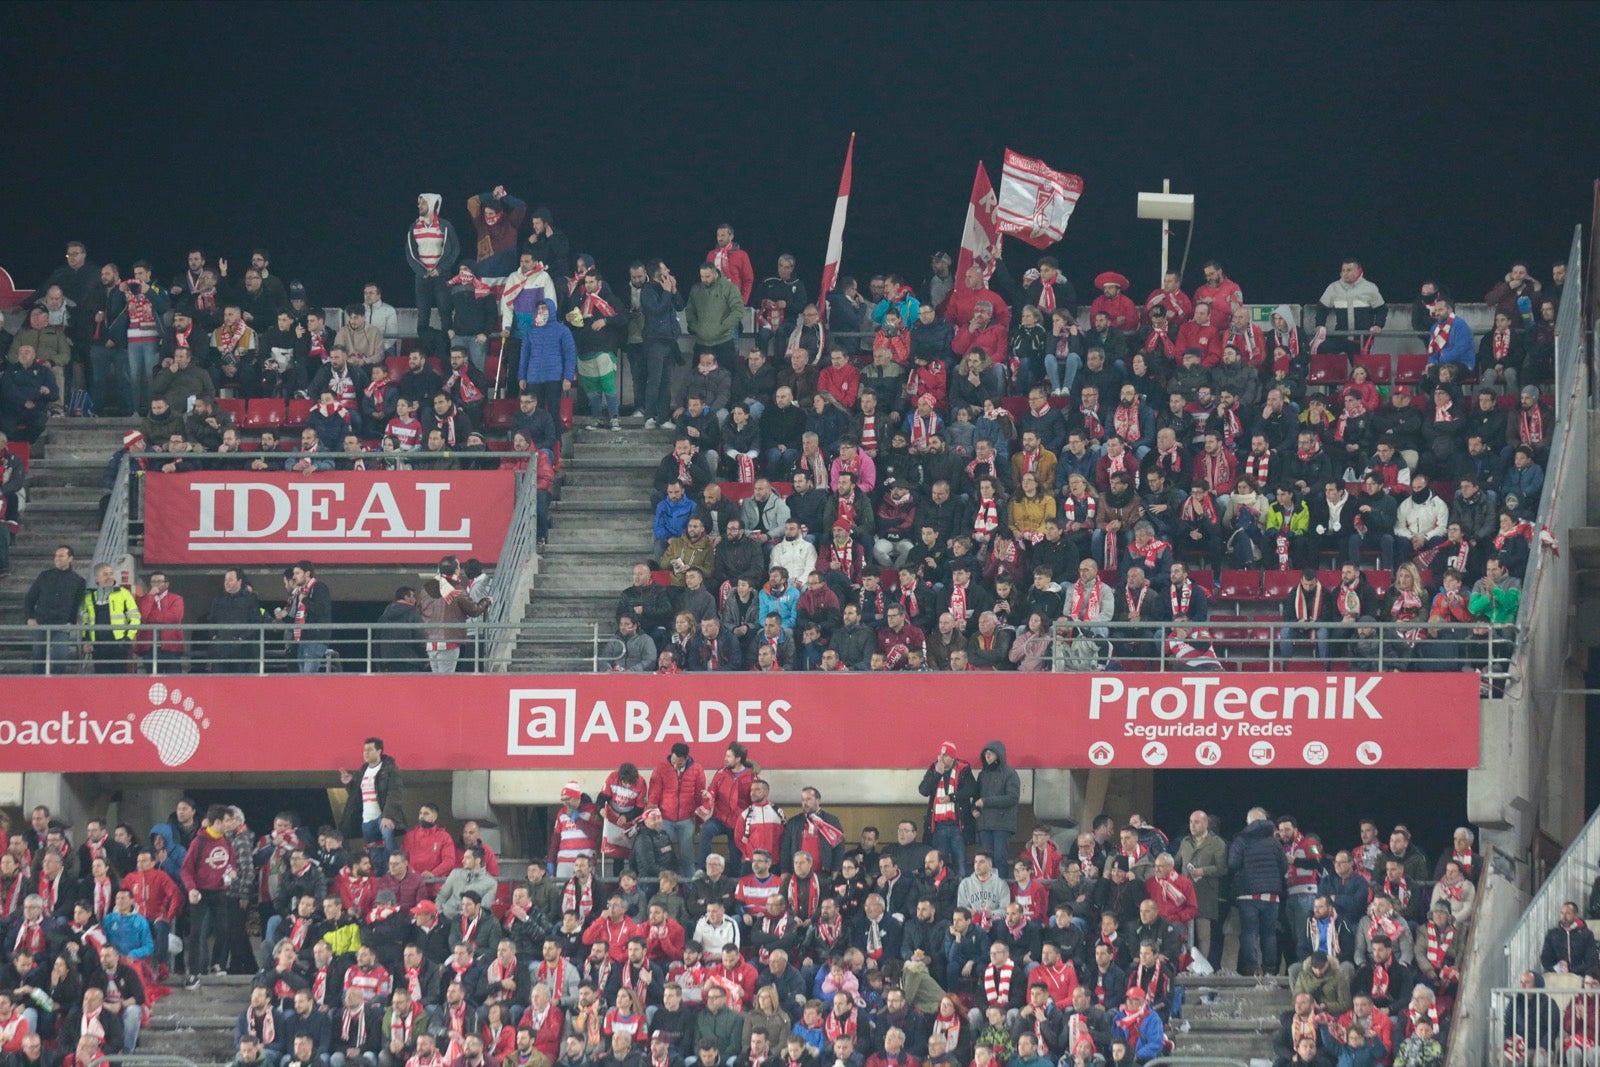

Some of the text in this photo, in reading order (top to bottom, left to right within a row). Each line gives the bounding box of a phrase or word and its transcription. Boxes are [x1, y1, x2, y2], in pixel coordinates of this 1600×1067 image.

[189, 482, 471, 538] IDEAL
[1089, 676, 1383, 720] ProTecniK
[0, 711, 134, 745] oactiva
[579, 699, 793, 744] ABADES
[1124, 721, 1293, 741] Seguridad y Redes
